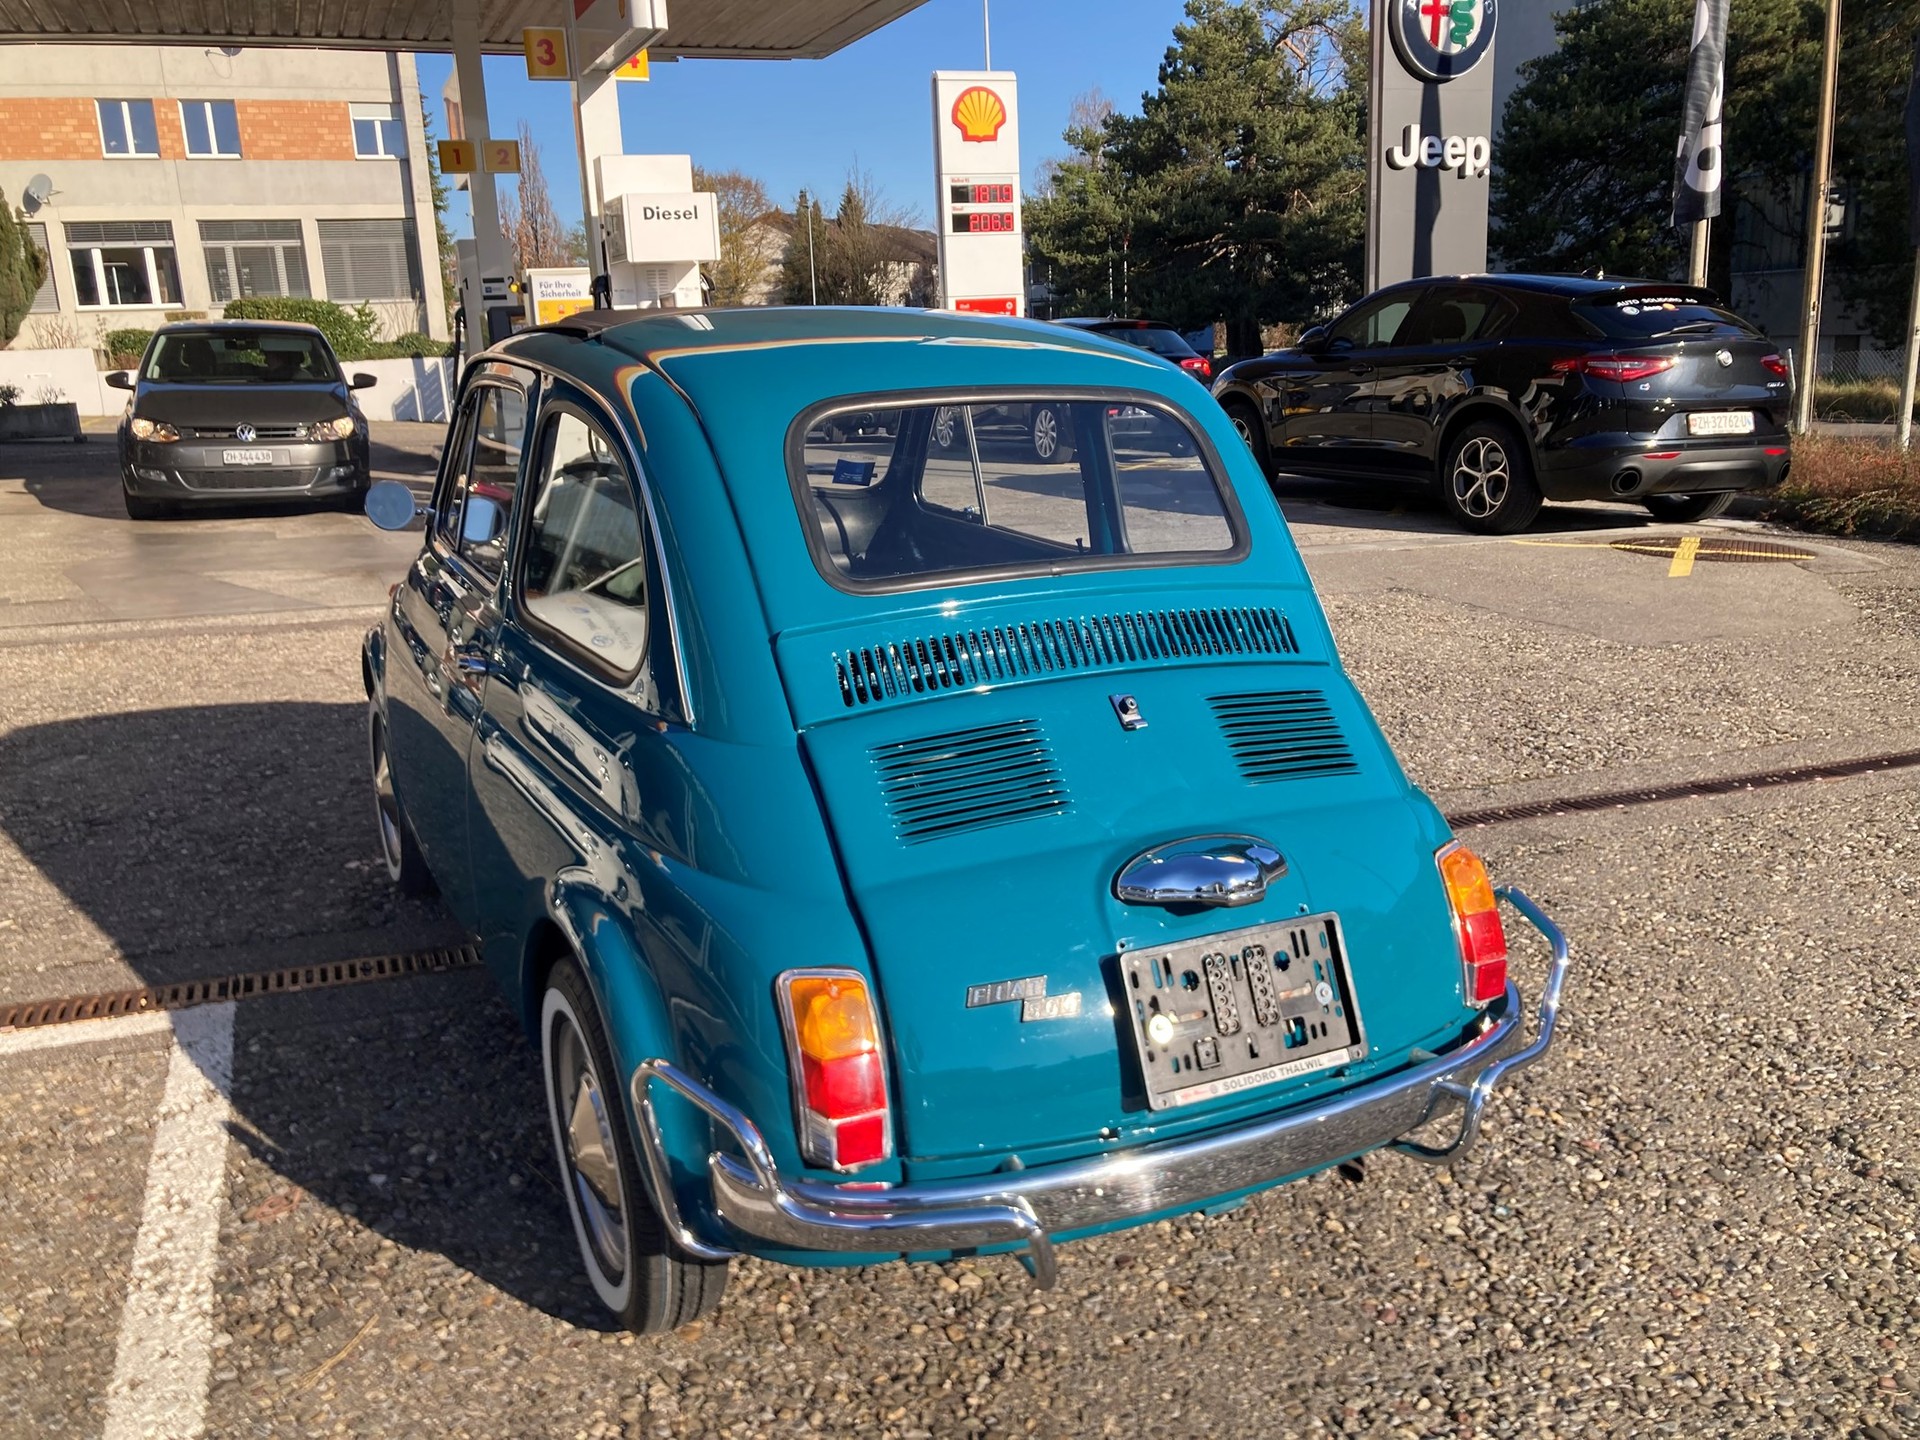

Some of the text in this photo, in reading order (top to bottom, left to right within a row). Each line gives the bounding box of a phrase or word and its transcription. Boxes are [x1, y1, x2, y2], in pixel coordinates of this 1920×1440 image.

[536, 38, 557, 66] 3
[452, 148, 461, 165] 1
[496, 149, 510, 166] 2
[1393, 123, 1491, 177] Jeep
[974, 184, 1013, 203] 187.9
[642, 205, 699, 221] Diesel
[969, 213, 1013, 232] 206.9
[539, 280, 572, 290] Für Ihre
[540, 289, 582, 298] Sicherheit
[1616, 299, 1640, 308] AUTO
[973, 980, 1041, 1003] FIAT
[1222, 1058, 1324, 1091] SOLIDORO THALWIL
